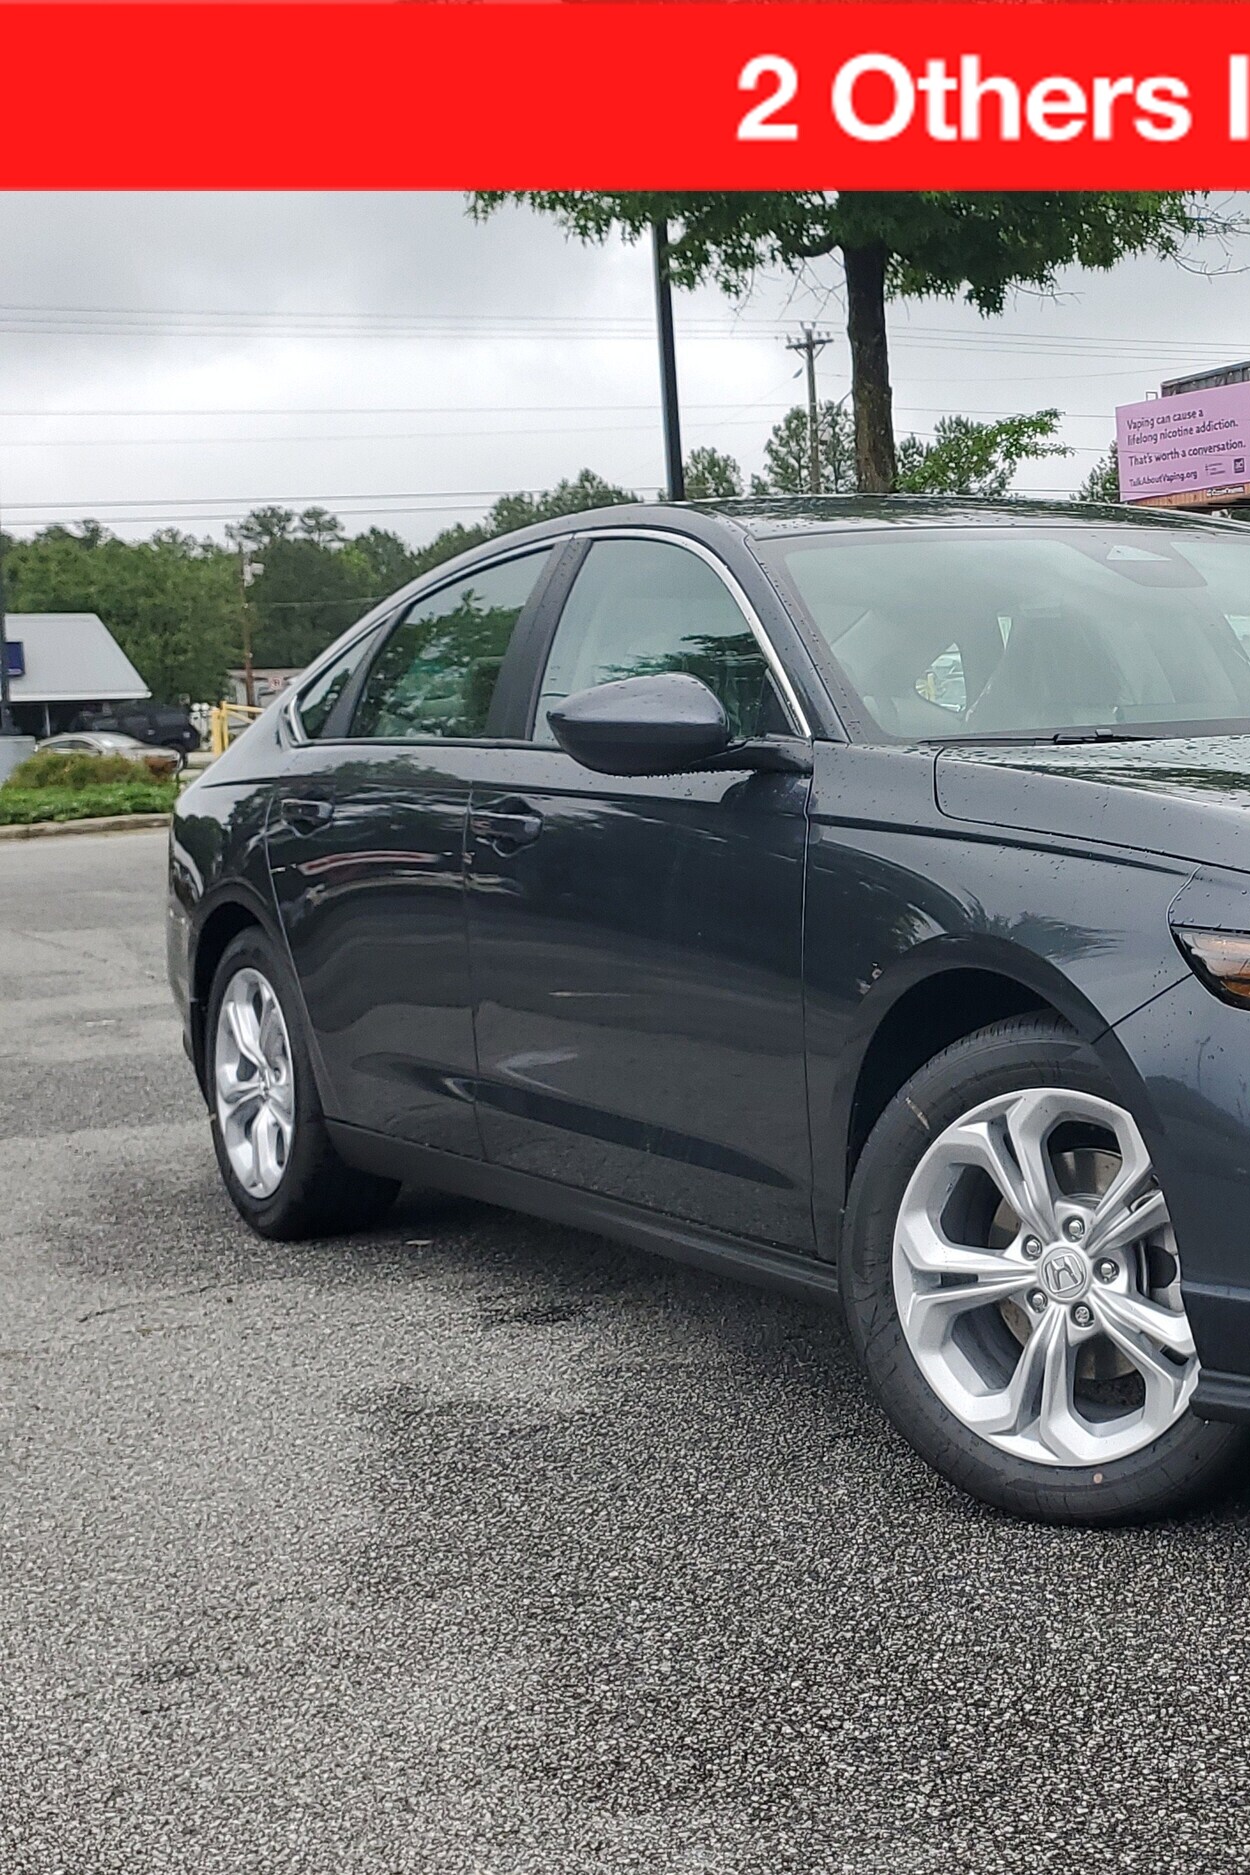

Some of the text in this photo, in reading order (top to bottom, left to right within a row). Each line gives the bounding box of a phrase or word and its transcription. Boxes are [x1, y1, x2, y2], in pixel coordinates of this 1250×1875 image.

[1126, 409, 1204, 432] Vaping can cause a
[1127, 419, 1239, 446] lifelong nicotine addiction.
[1128, 440, 1246, 467] That's worth a conversation.
[1129, 470, 1198, 487] TalkAboutVaping.org
